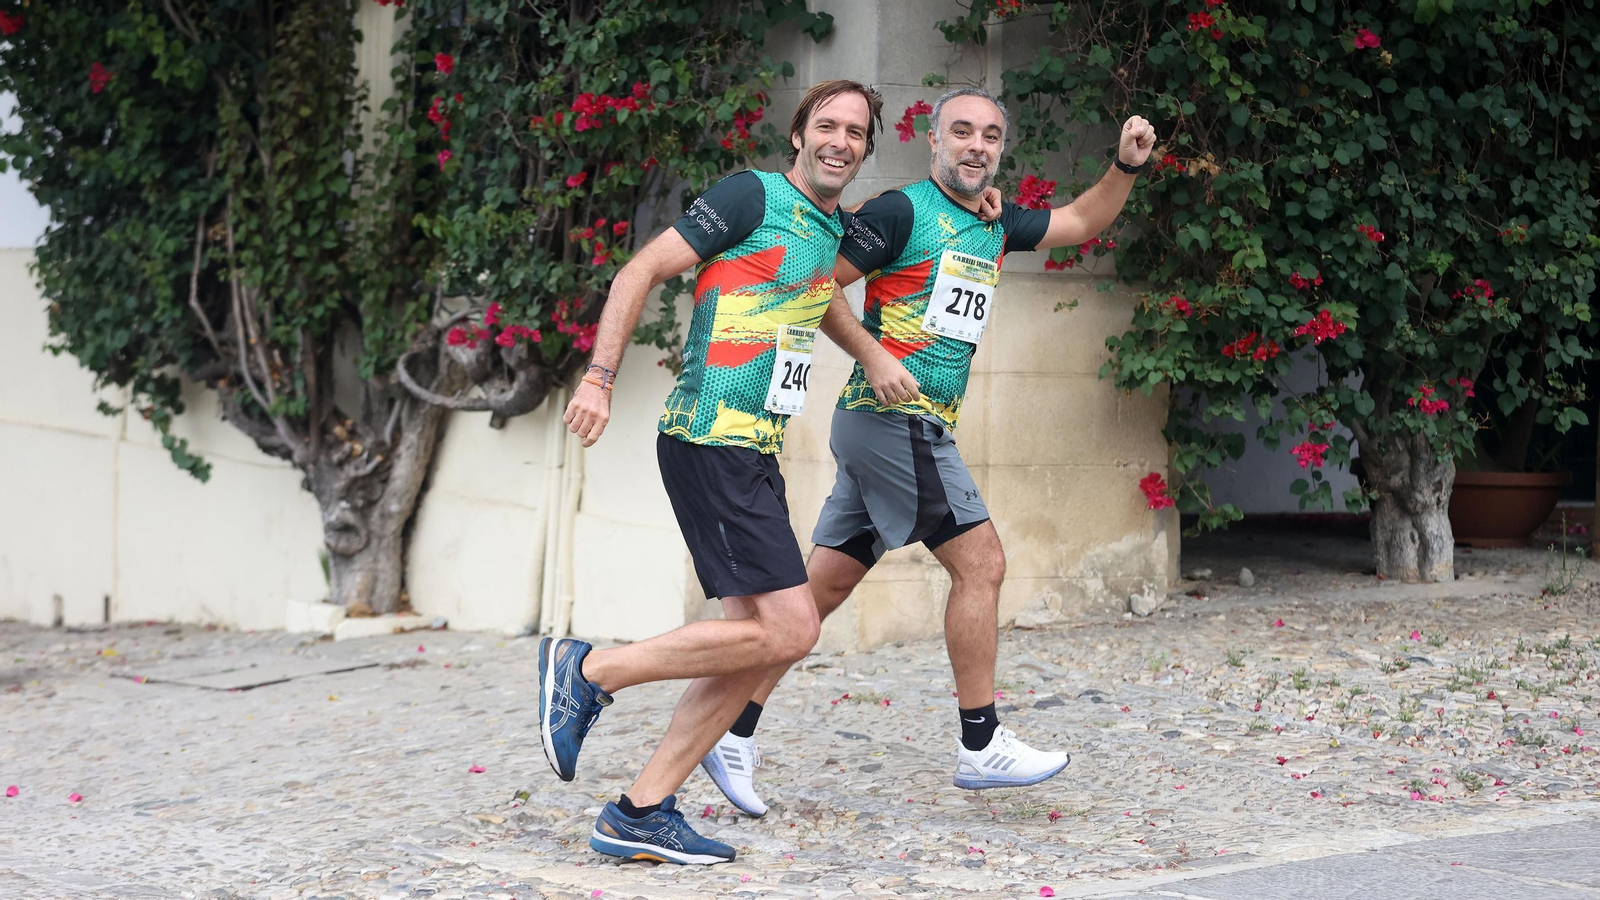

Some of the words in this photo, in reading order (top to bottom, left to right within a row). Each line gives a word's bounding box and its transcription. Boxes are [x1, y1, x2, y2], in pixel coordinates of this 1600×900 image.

[696, 198, 729, 233] Diputación
[696, 214, 715, 235] Cádiz
[853, 233, 873, 252] Cádiz
[945, 287, 987, 321] 278
